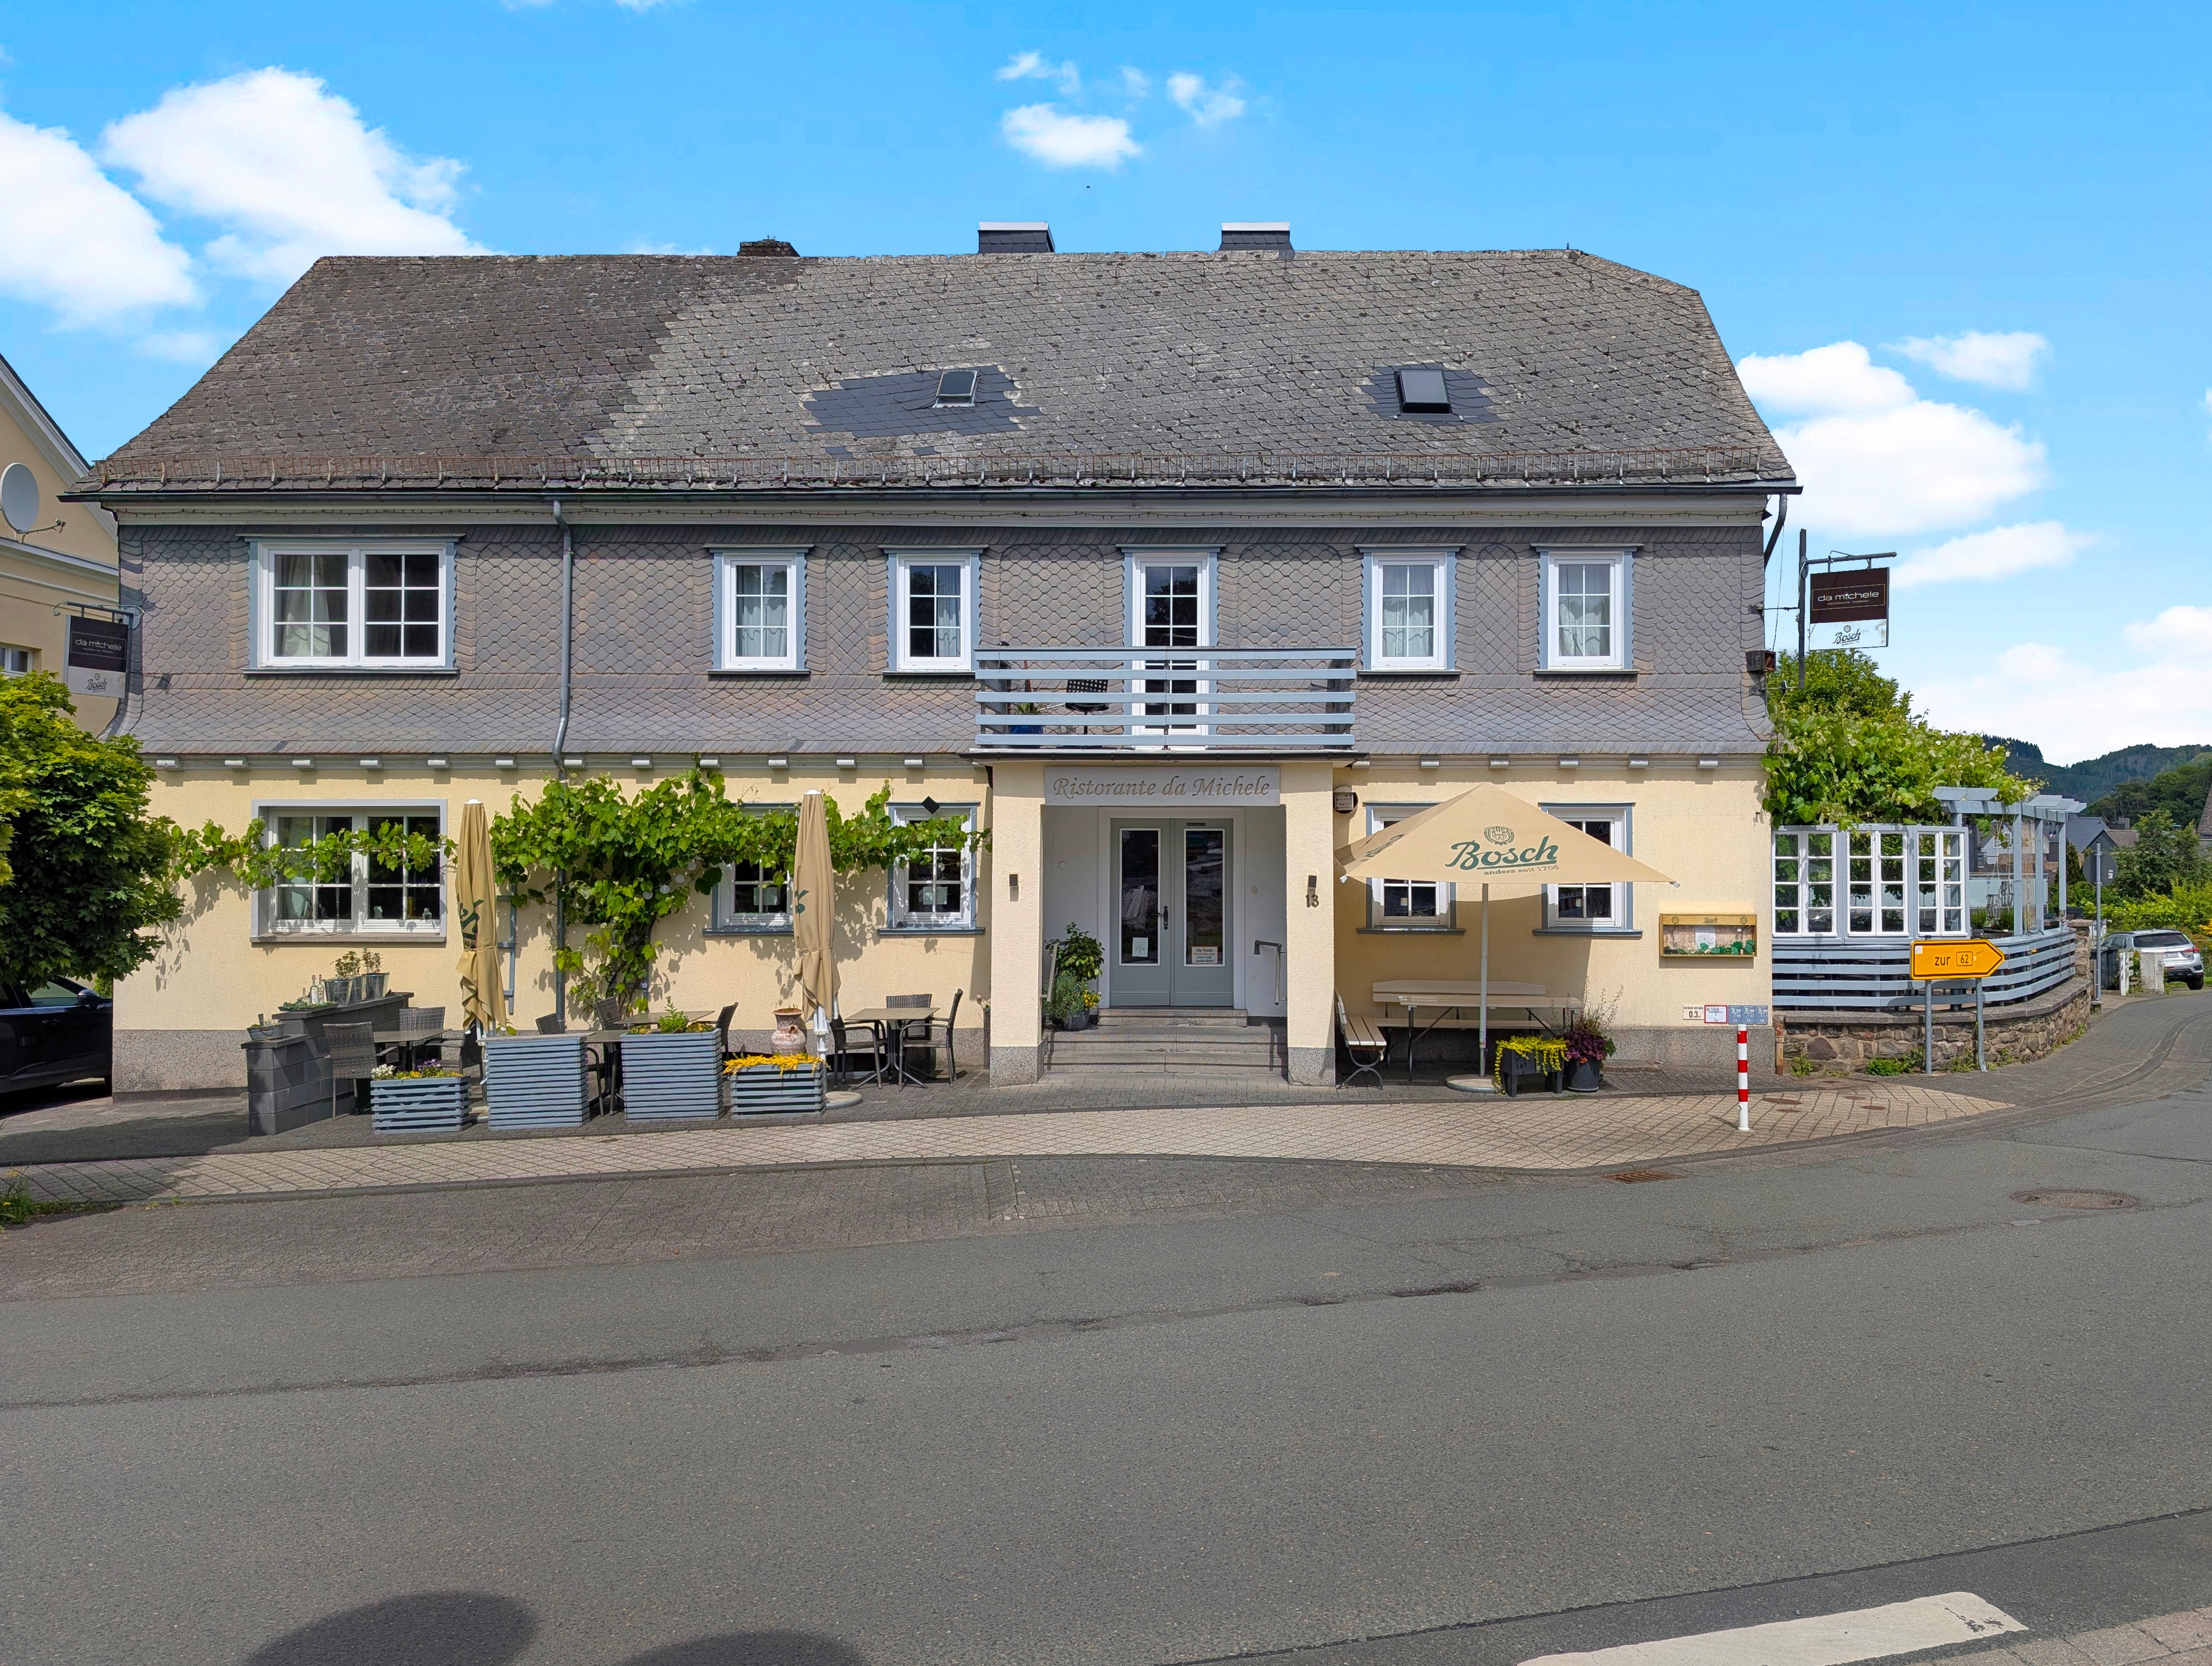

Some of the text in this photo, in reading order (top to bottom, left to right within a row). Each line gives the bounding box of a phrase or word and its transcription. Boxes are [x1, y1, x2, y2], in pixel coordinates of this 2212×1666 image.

[1835, 591, 1879, 600] michele
[1832, 629, 1861, 644] Bosch
[88, 640, 122, 651] michele
[86, 678, 107, 690] Bosch
[1053, 776, 1270, 800] Ristorante da Michele
[1444, 835, 1559, 870] Bosch
[1306, 894, 1319, 908] 13
[1934, 954, 1969, 966] zur 62
